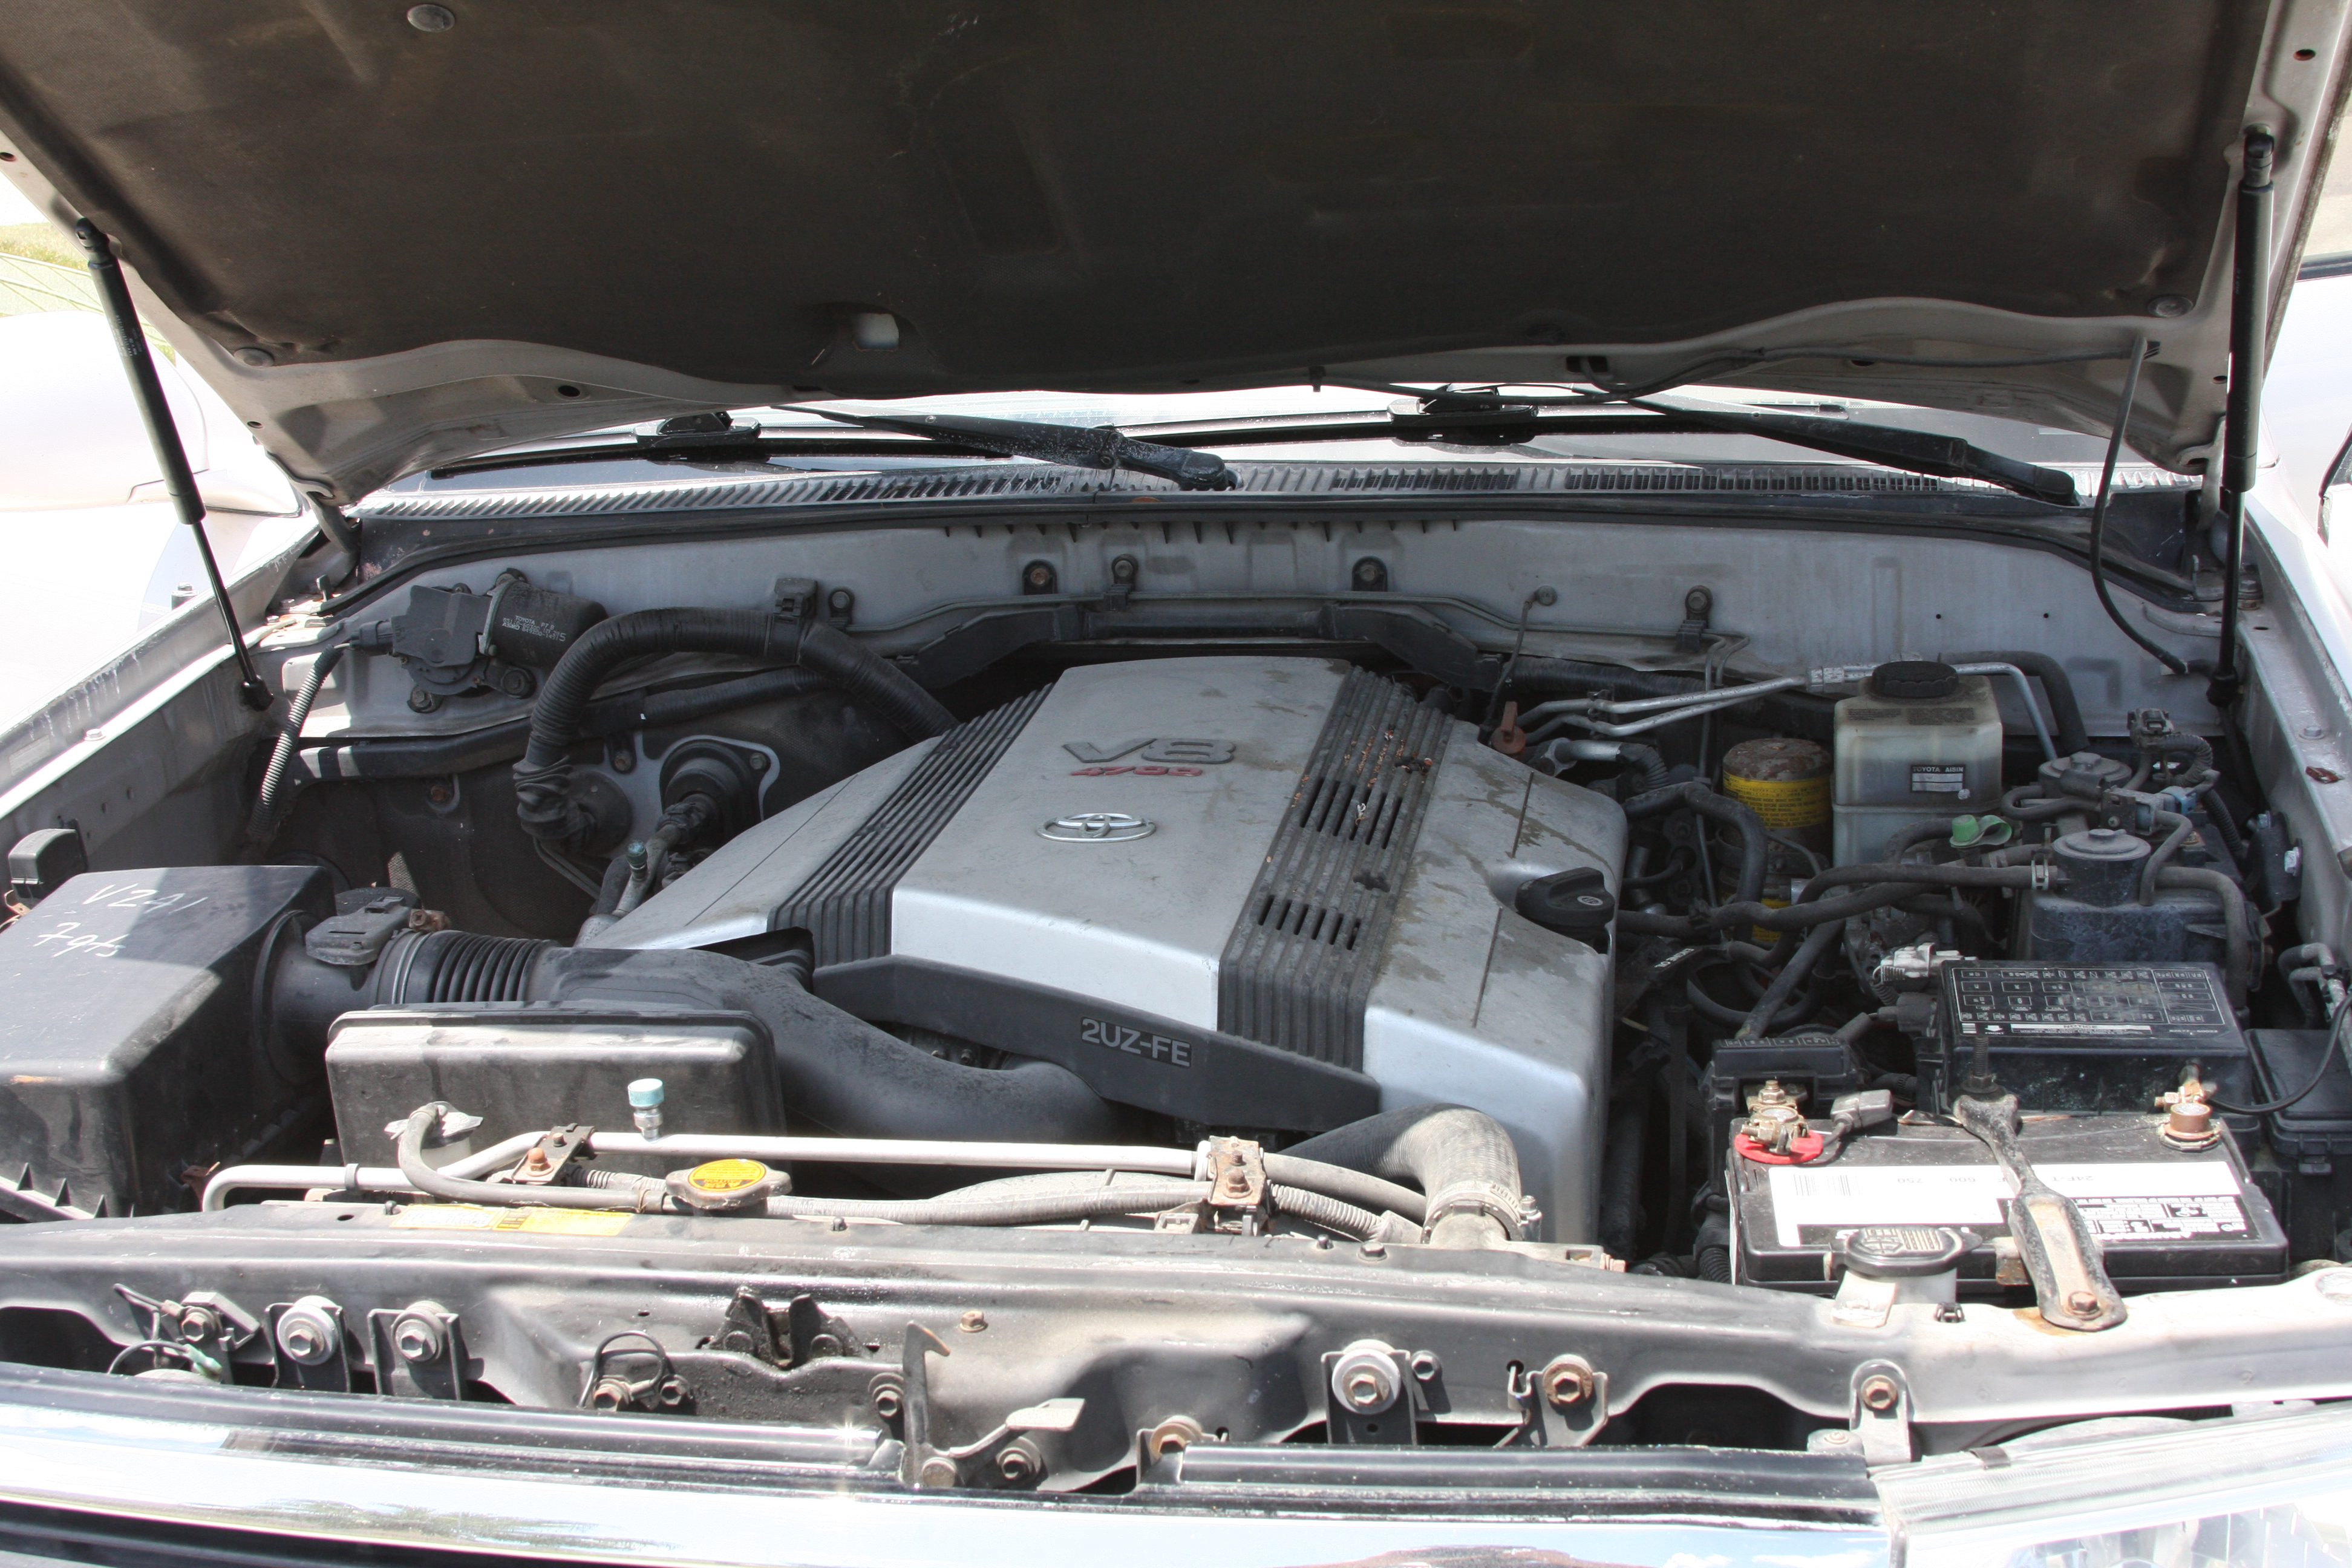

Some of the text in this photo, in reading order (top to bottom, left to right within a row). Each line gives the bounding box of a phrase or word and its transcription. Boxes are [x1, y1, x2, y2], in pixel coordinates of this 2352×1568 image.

[515, 615, 535, 625] TOYOTA
[1062, 737, 1236, 765] V8
[1070, 765, 1203, 777] 4700
[1082, 1018, 1191, 1067] 2UZ-FE
